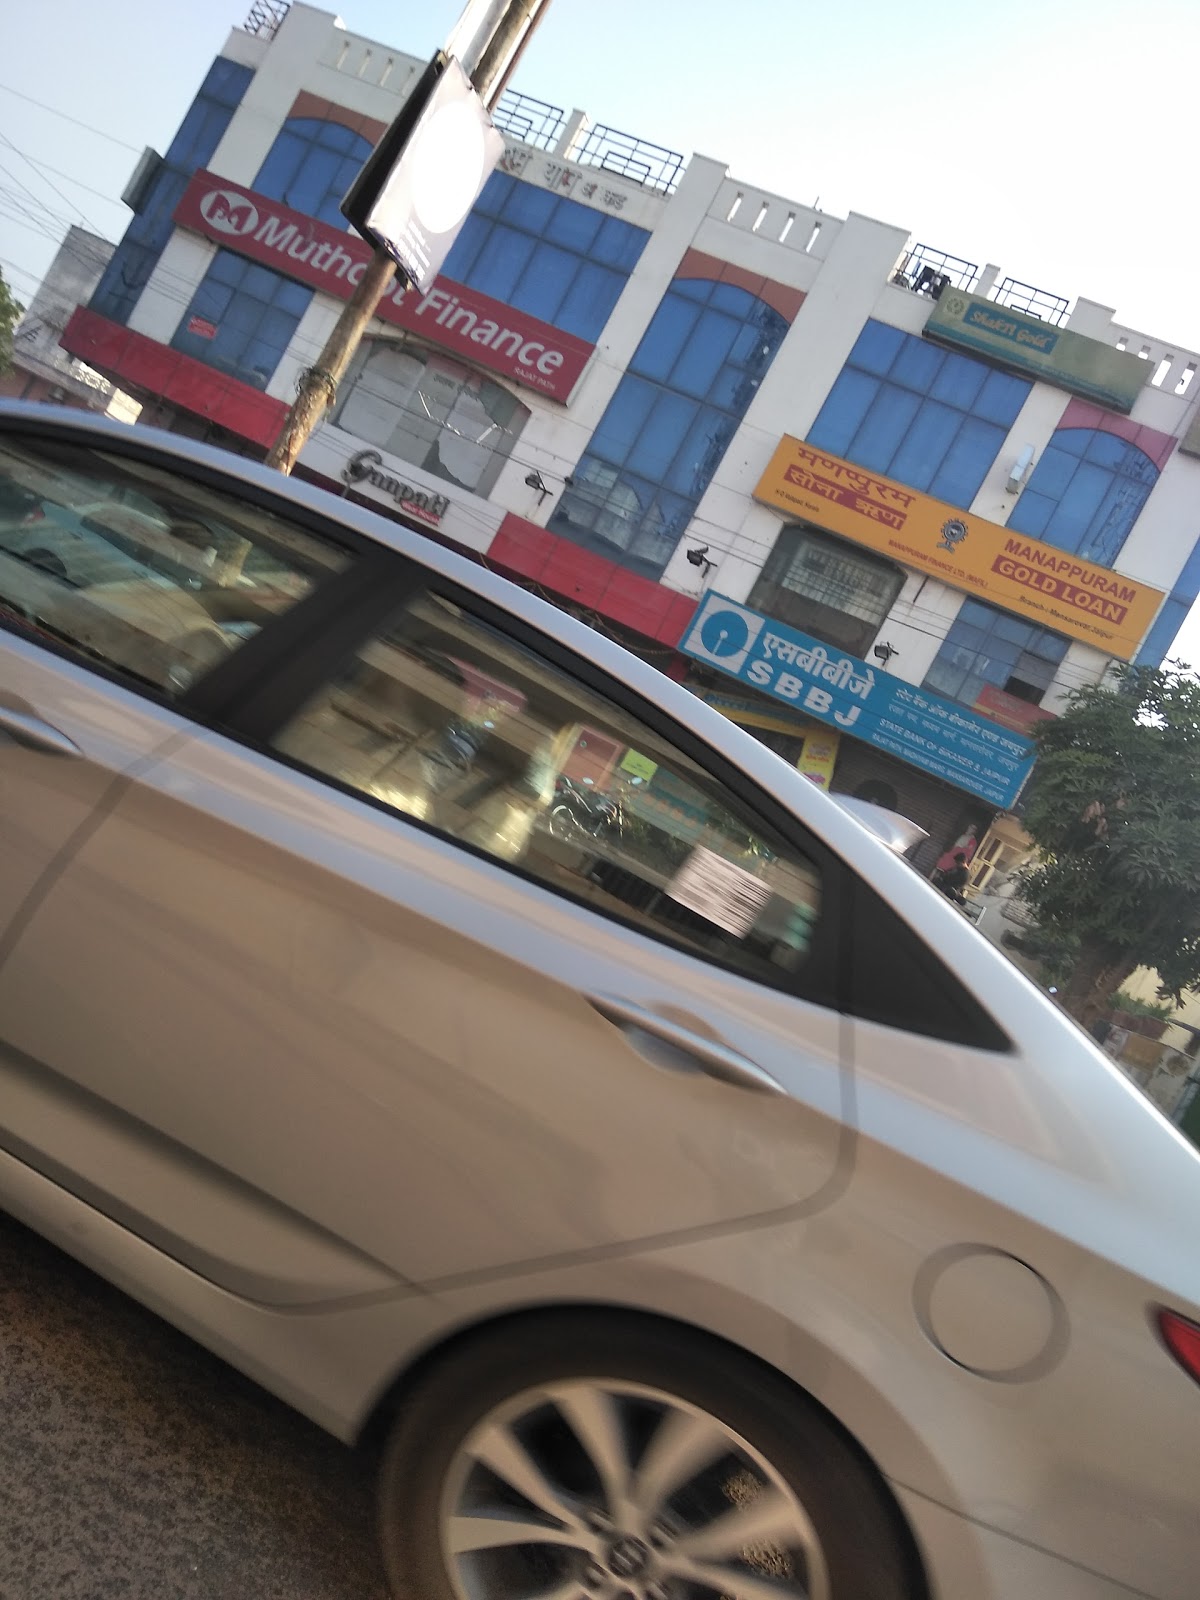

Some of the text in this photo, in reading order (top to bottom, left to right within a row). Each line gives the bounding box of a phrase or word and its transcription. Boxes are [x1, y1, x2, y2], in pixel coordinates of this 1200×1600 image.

[415, 288, 564, 375] Finance
[789, 468, 907, 527] सोना ऋण
[888, 539, 928, 561] MANAPPURAM
[928, 556, 953, 573] FINANCE
[1004, 538, 1136, 604] MANAPPURAM
[999, 560, 1123, 621] GOLD LOAN
[746, 660, 862, 726] SBBJ
[763, 631, 876, 701] एसबीबीजे
[880, 718, 904, 735] STATE
[904, 729, 926, 746] BANK
[926, 740, 938, 750] OF
